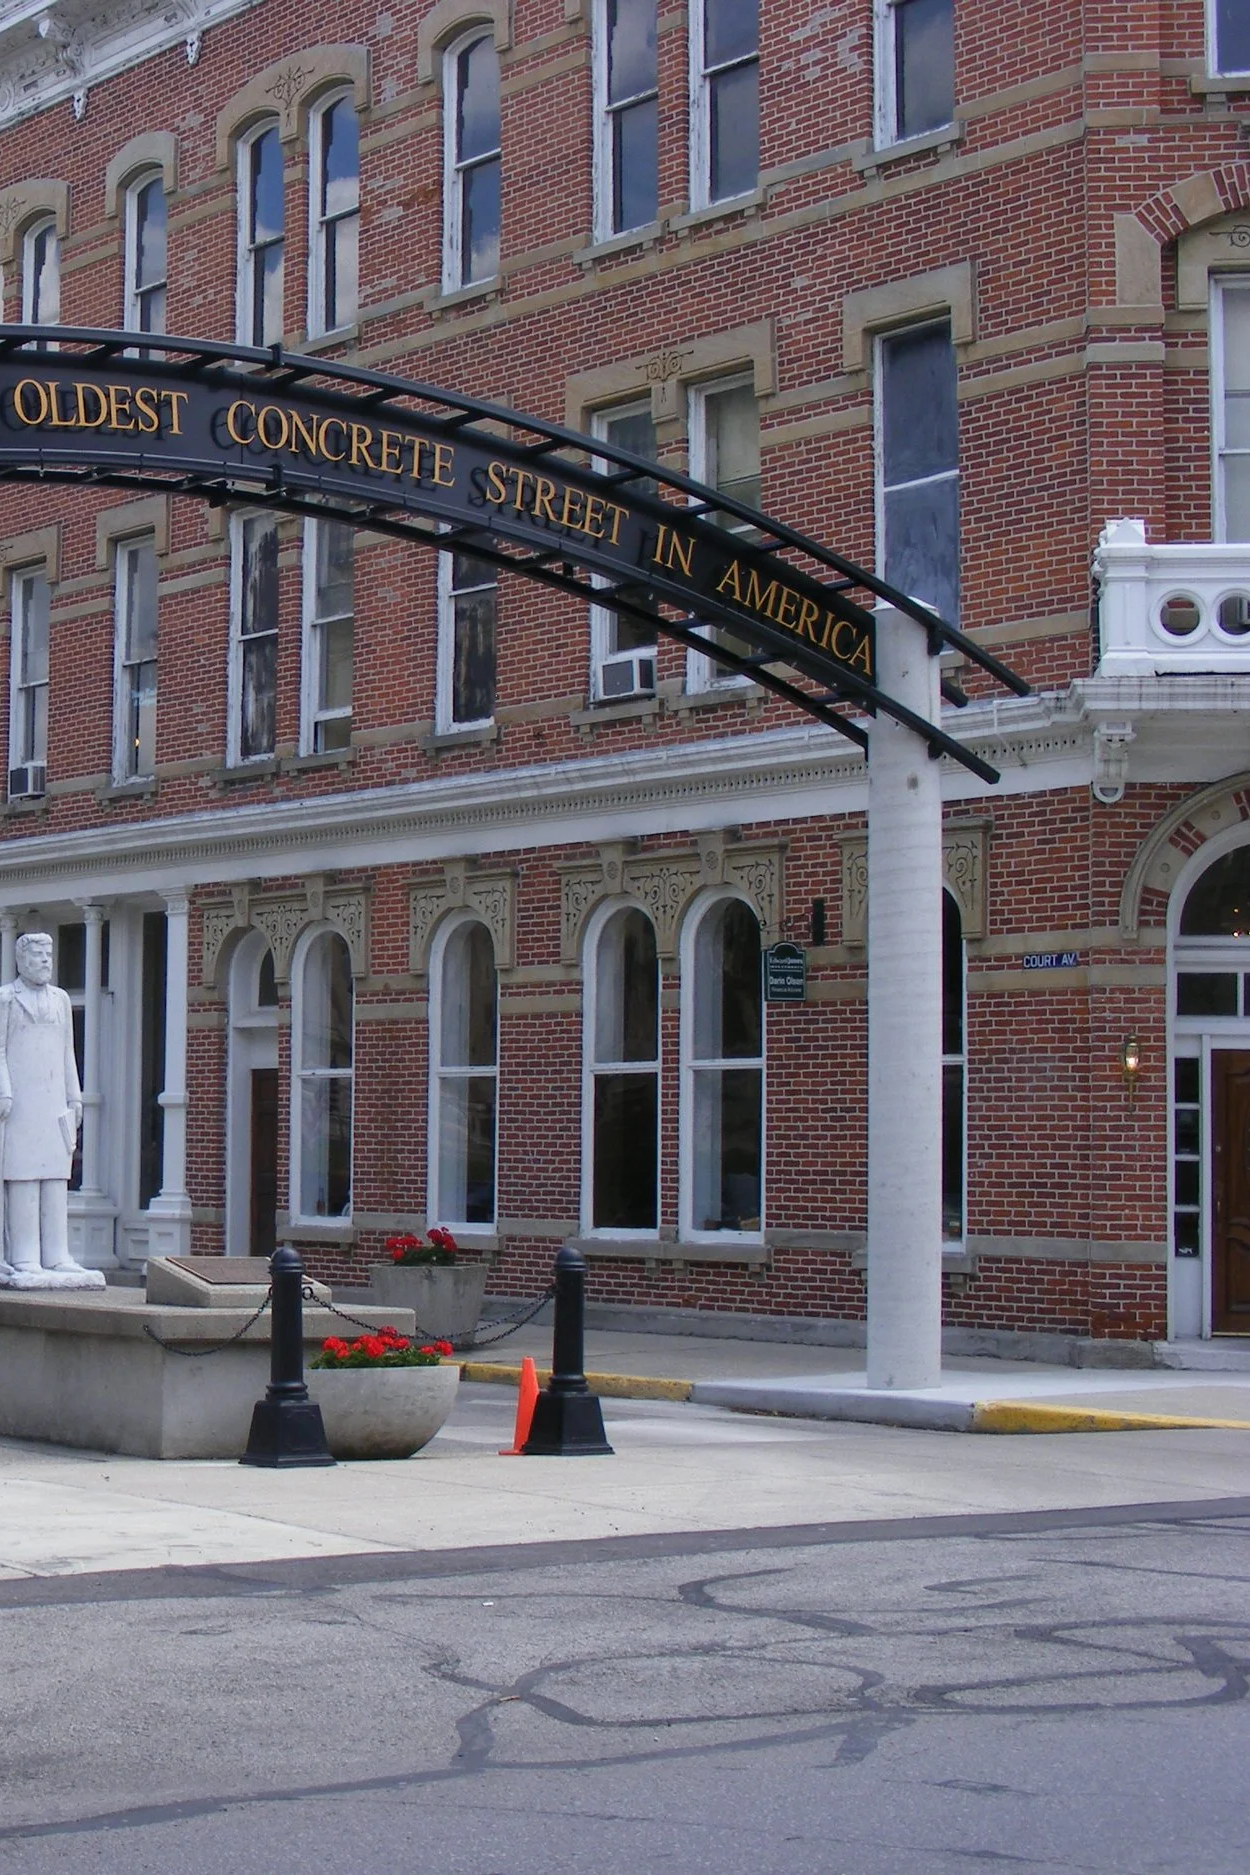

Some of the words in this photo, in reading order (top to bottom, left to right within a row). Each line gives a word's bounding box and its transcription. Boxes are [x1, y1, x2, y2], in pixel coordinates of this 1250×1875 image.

[14, 379, 189, 435] OLDEST
[227, 400, 456, 488] CONCRETE
[486, 460, 630, 547] STREET
[652, 523, 699, 578] IN
[715, 558, 874, 677] AMERICA
[1023, 954, 1057, 968] COURT
